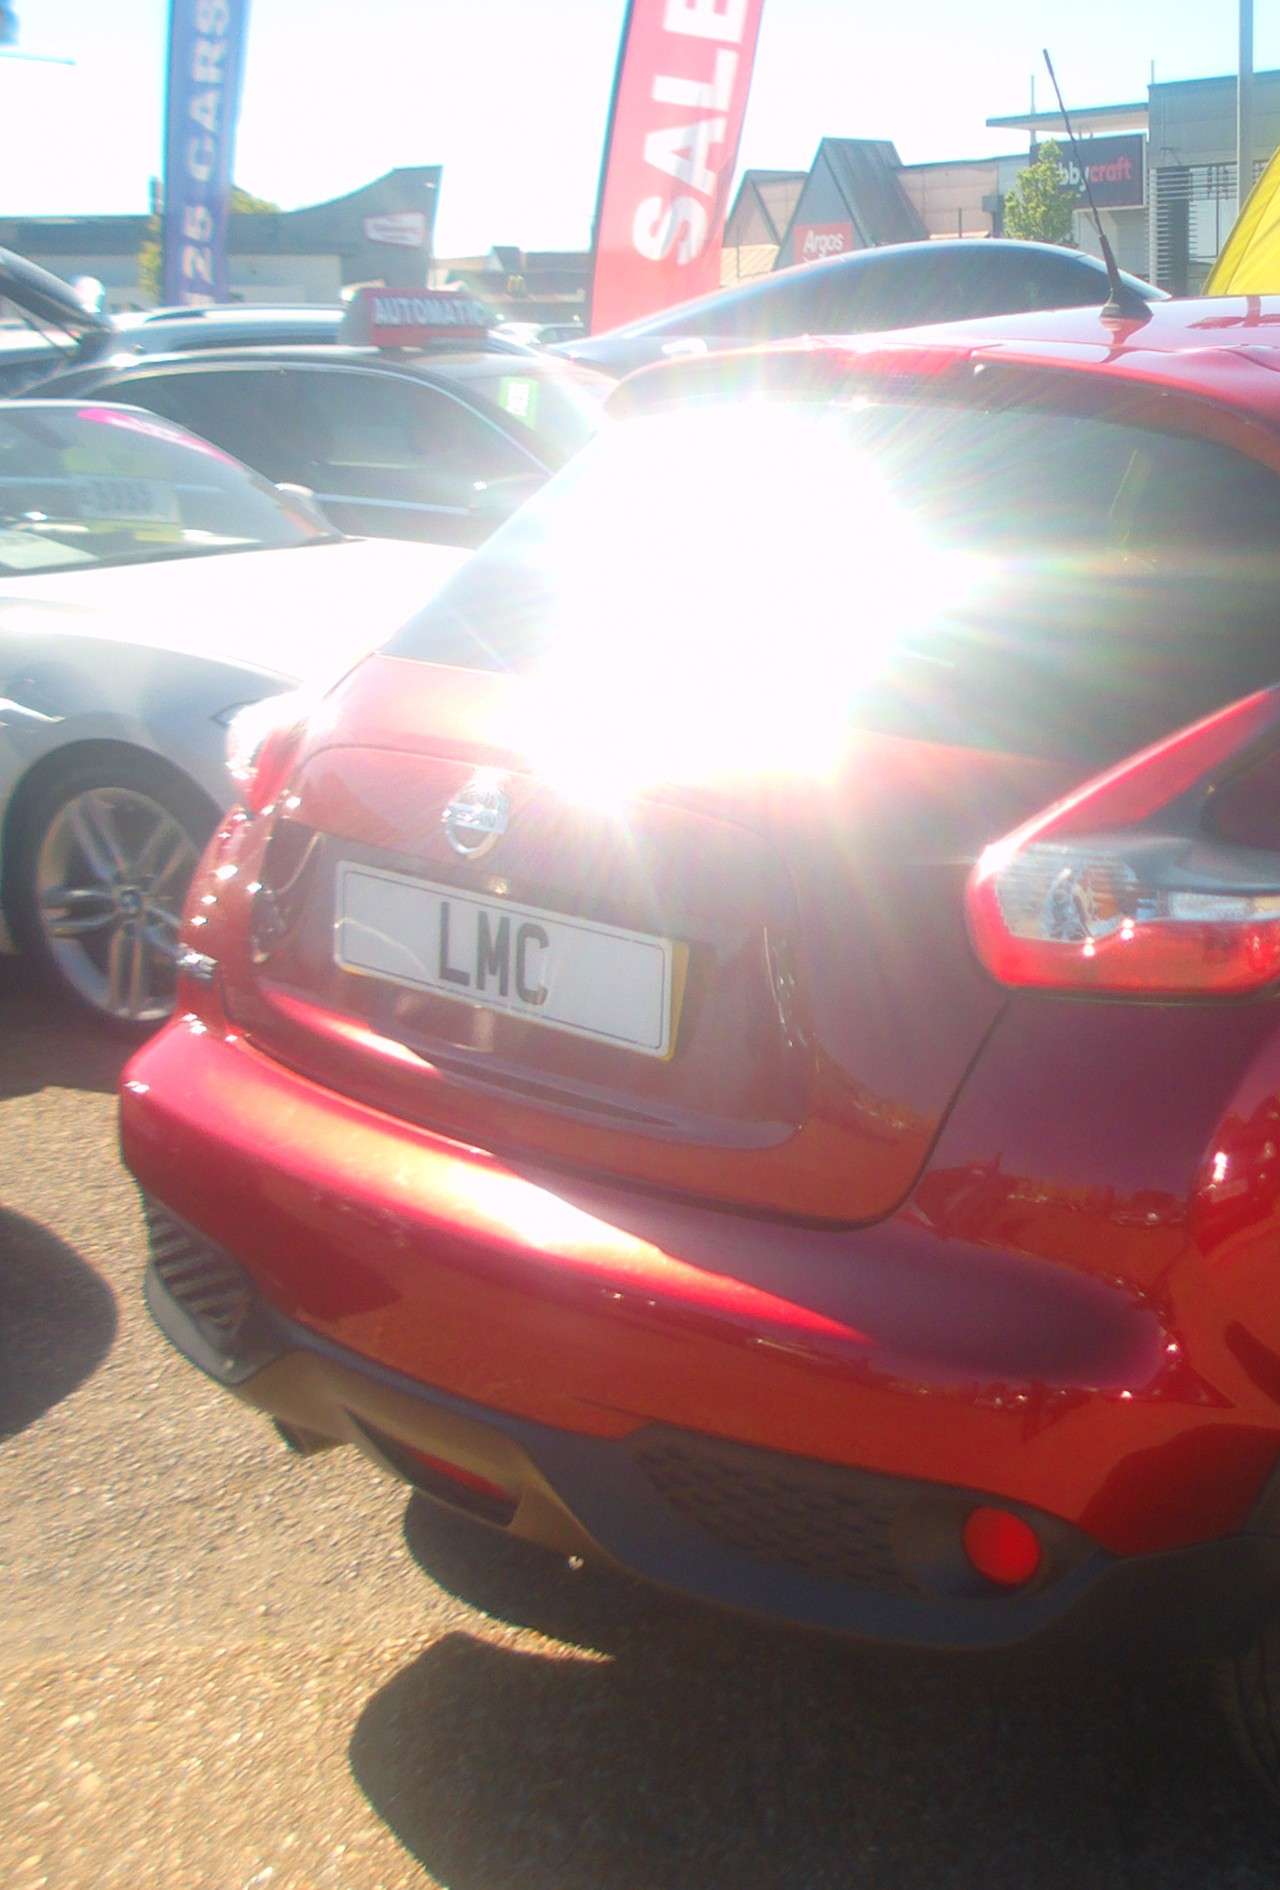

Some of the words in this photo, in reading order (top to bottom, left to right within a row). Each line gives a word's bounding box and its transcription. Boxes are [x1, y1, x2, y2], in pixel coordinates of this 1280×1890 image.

[187, 0, 230, 182] CARS
[632, 0, 748, 266] SALE
[1057, 156, 1132, 192] bbycraft
[802, 229, 845, 258] Argos
[374, 297, 488, 326] AUTOMATIC
[438, 901, 550, 1006] LMC
